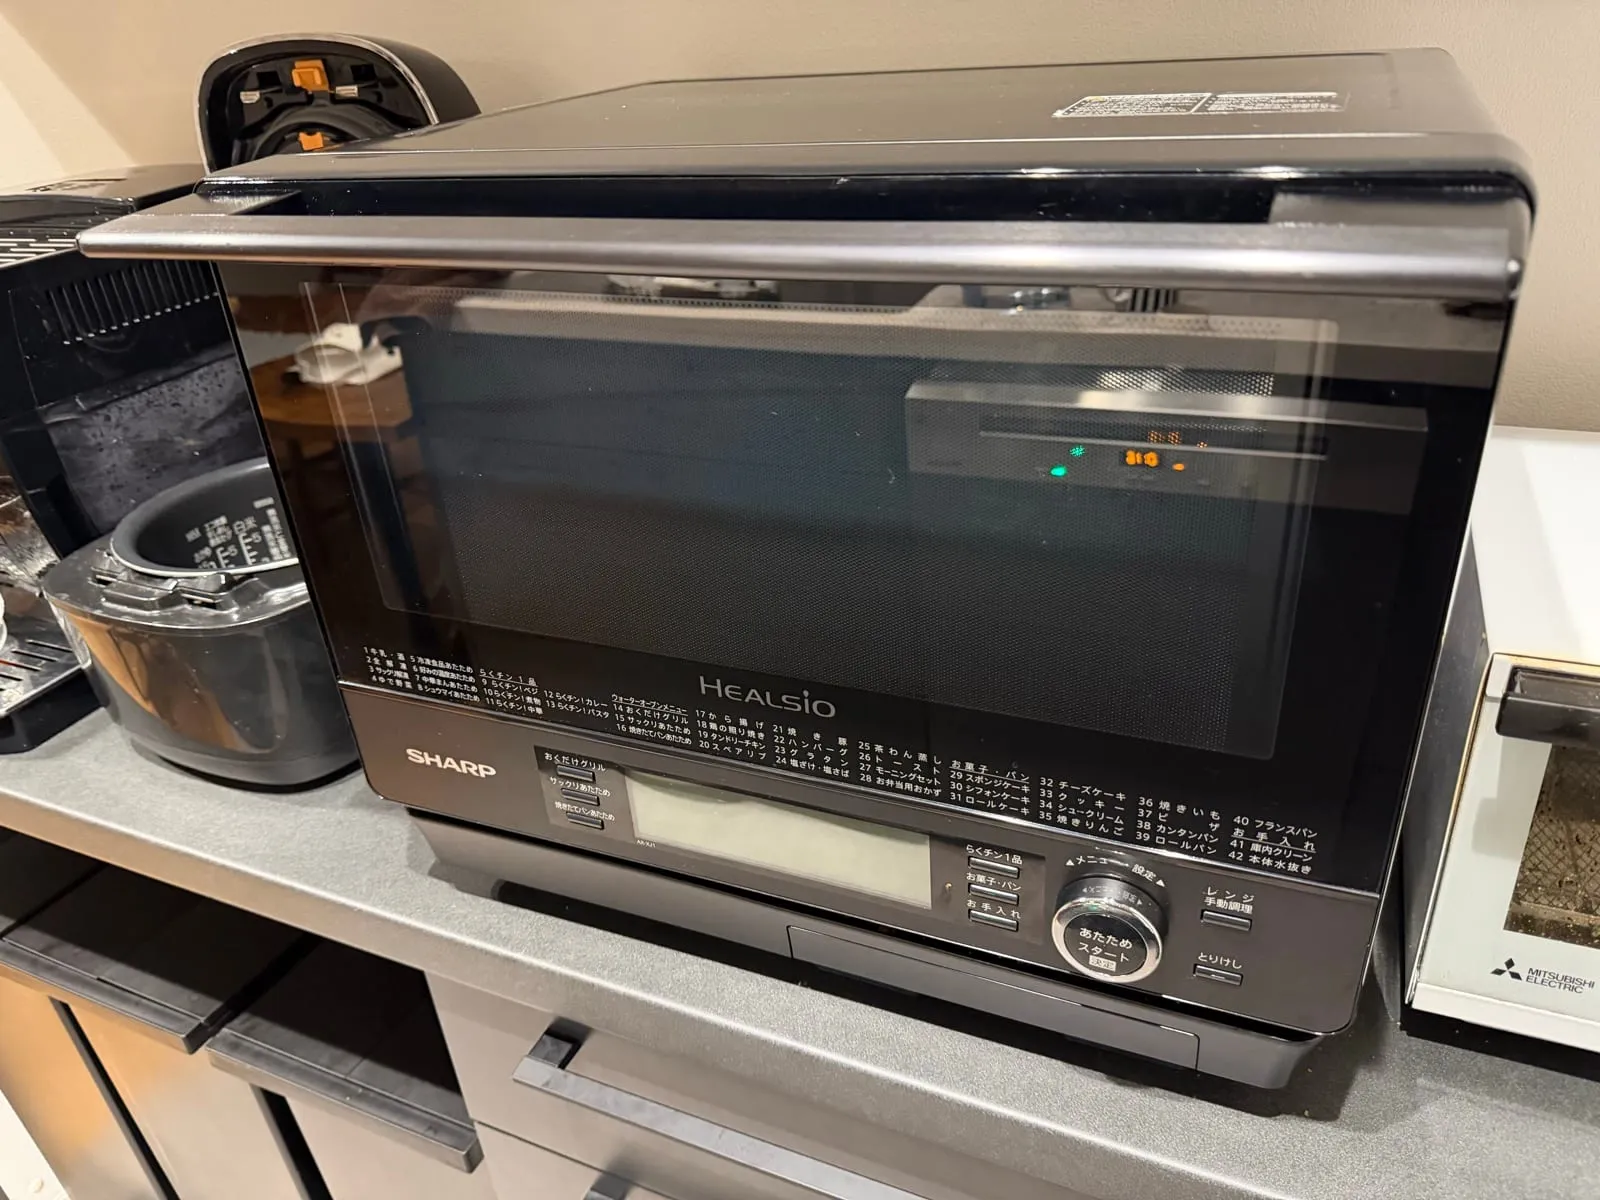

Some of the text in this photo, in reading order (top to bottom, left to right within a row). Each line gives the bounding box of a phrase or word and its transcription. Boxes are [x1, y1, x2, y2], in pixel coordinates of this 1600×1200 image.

[483, 688, 493, 696] 10
[485, 697, 494, 705] 11
[544, 690, 553, 699] 12
[546, 700, 555, 708] 13
[613, 704, 689, 724] 14 おくだけグリル
[695, 709, 705, 718] 17
[615, 713, 691, 735] 15 サックリあたため
[616, 723, 627, 732] 16
[696, 720, 707, 728] 18
[773, 724, 783, 733] 21
[698, 730, 766, 749] 19 タンドリーチキン
[699, 740, 710, 749] 20
[774, 735, 848, 756] 22 ハンバーグ
[406, 748, 496, 778] SHARP
[544, 752, 605, 771] おくだけグリル
[775, 745, 849, 766] 23 グラタン
[776, 756, 786, 764] 24
[858, 741, 941, 765] 25 茶わん蒸し
[859, 752, 941, 775] 26 トースト
[859, 763, 941, 785] 27 モーニングセット
[950, 770, 1030, 793] 29 スポンジケーキ
[550, 777, 611, 797] サックリあたため
[860, 774, 942, 796] 28 お弁当用おかず
[950, 781, 1030, 805] 30 シフォンケーキ
[1040, 777, 1126, 802] 32 チーズケーキ
[950, 792, 1030, 815] 31 ロールケーキ
[1040, 788, 1125, 811] 33 クッキー
[1138, 797, 1221, 821] 36 焼きいも
[555, 801, 615, 821] 焼きたてパンあたため
[1039, 800, 1124, 824] 34 シュークリーム
[1138, 808, 1152, 818] 37
[1039, 811, 1124, 836] 35 焼きりんご
[1137, 820, 1219, 843] 38 カンタンパン
[1233, 815, 1318, 838] 40 フランスパン
[1136, 832, 1217, 855] 39 ロールパン
[1233, 828, 1316, 851] お手入れ
[1230, 839, 1313, 862] 41 庫内クリーン
[1132, 864, 1156, 882] 設定
[1228, 851, 1312, 875] 42 本体水抜き
[1207, 885, 1254, 903] レンジ
[967, 899, 1021, 919] お手入れ
[1204, 896, 1253, 914] 手動調理
[1080, 928, 1132, 949] あたため
[1078, 942, 1129, 962] スタート
[1198, 952, 1242, 970] とりけし
[1526, 976, 1583, 993] ELECTRIC
[1528, 968, 1595, 988] MITSUBISHI
